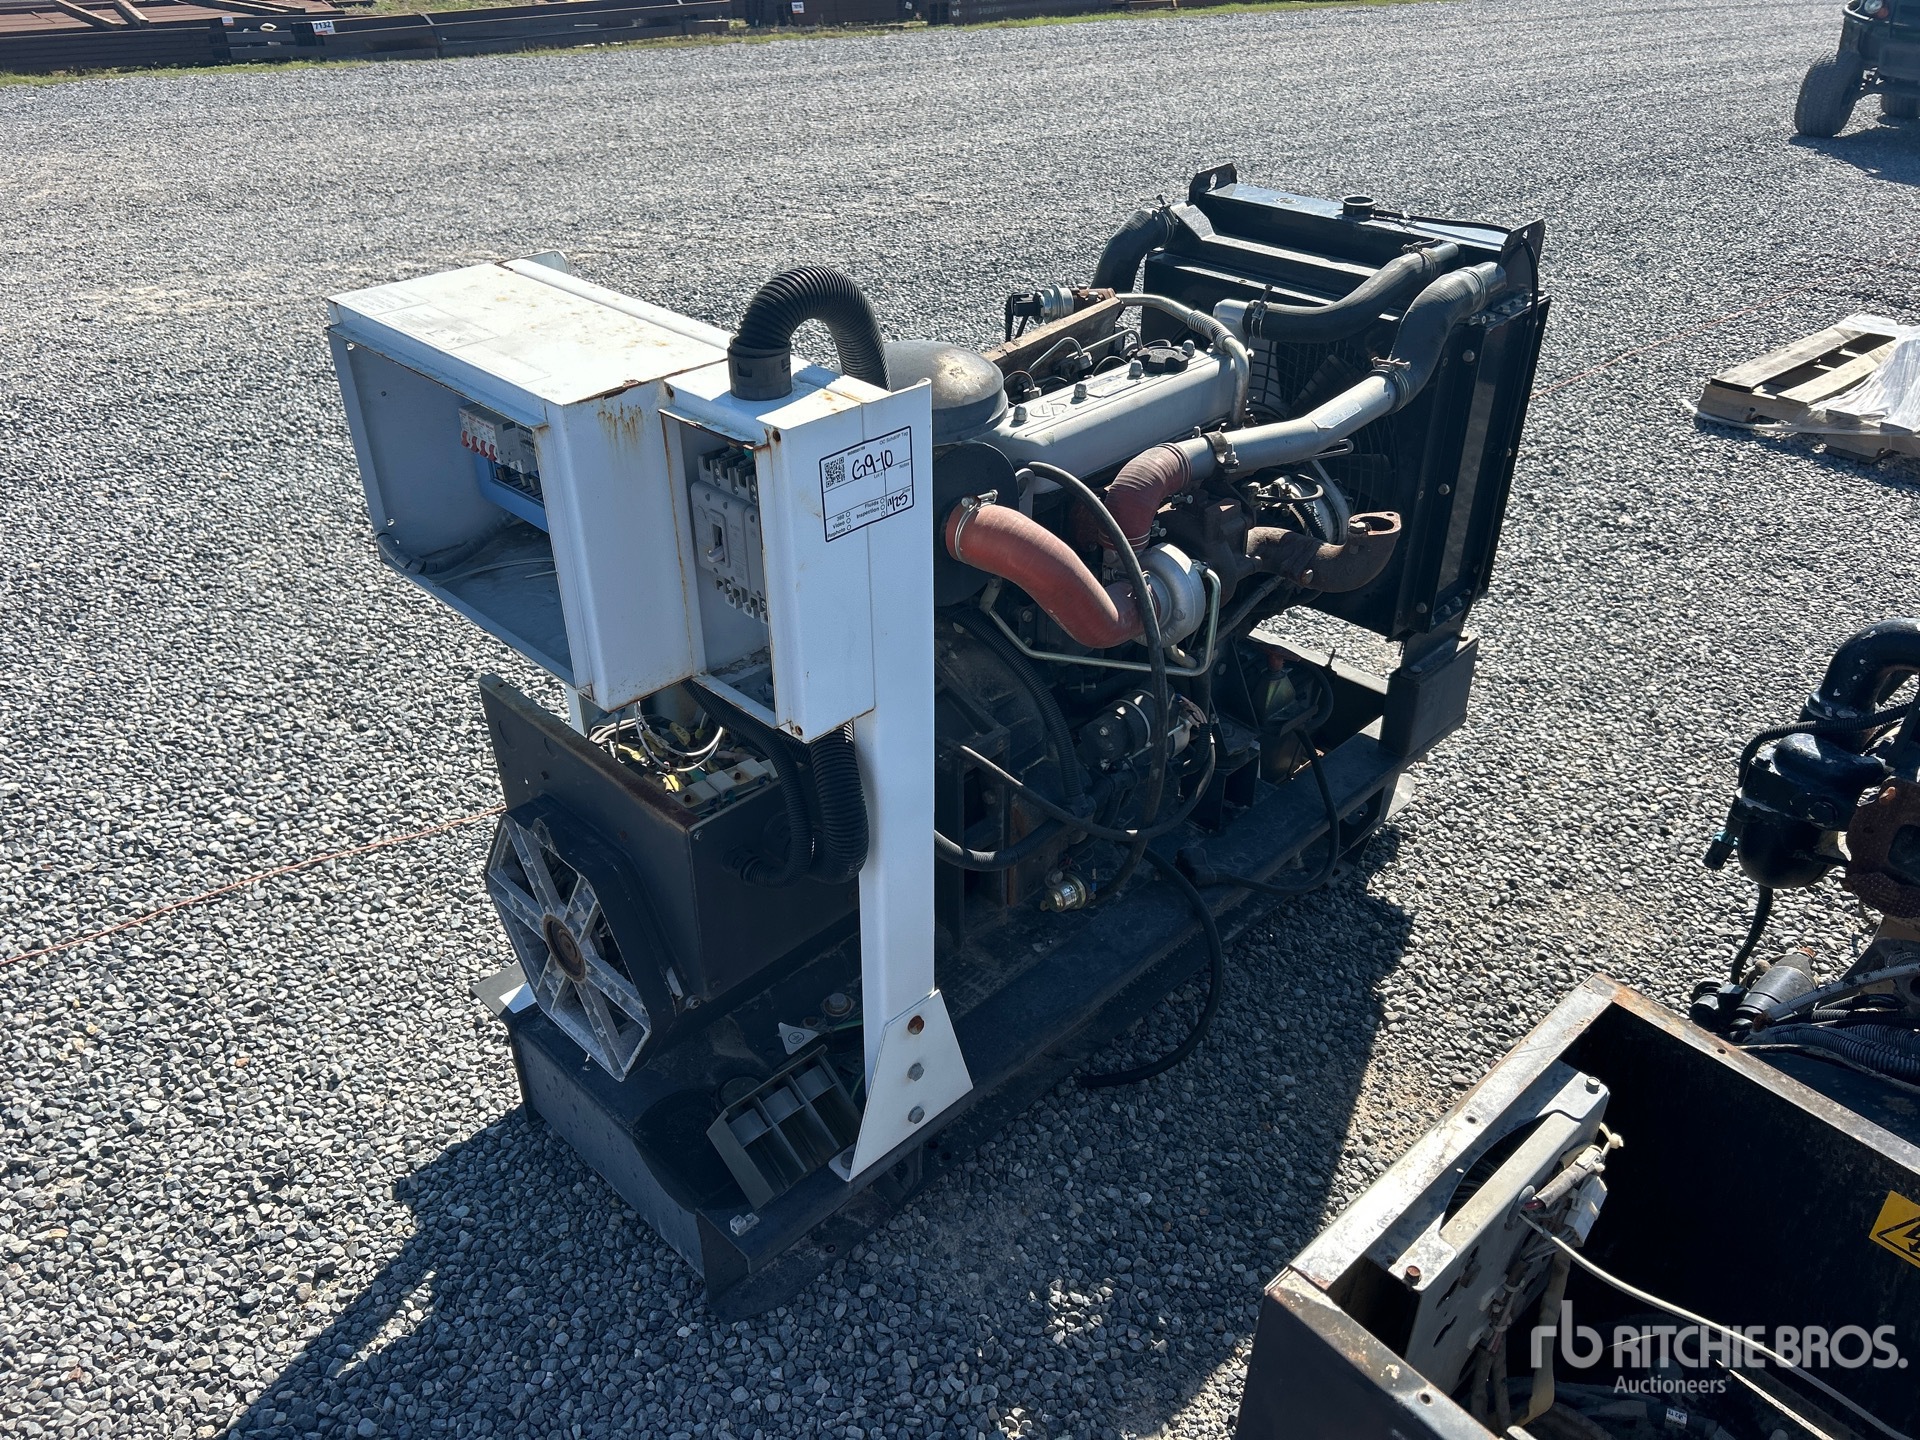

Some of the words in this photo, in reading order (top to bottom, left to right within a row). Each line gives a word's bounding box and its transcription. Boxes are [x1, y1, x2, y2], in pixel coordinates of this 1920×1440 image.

[313, 20, 332, 30] 7132
[852, 449, 893, 480] G9-10
[864, 500, 879, 509] Fluids
[856, 506, 880, 519] Inspection
[832, 521, 846, 529] Video
